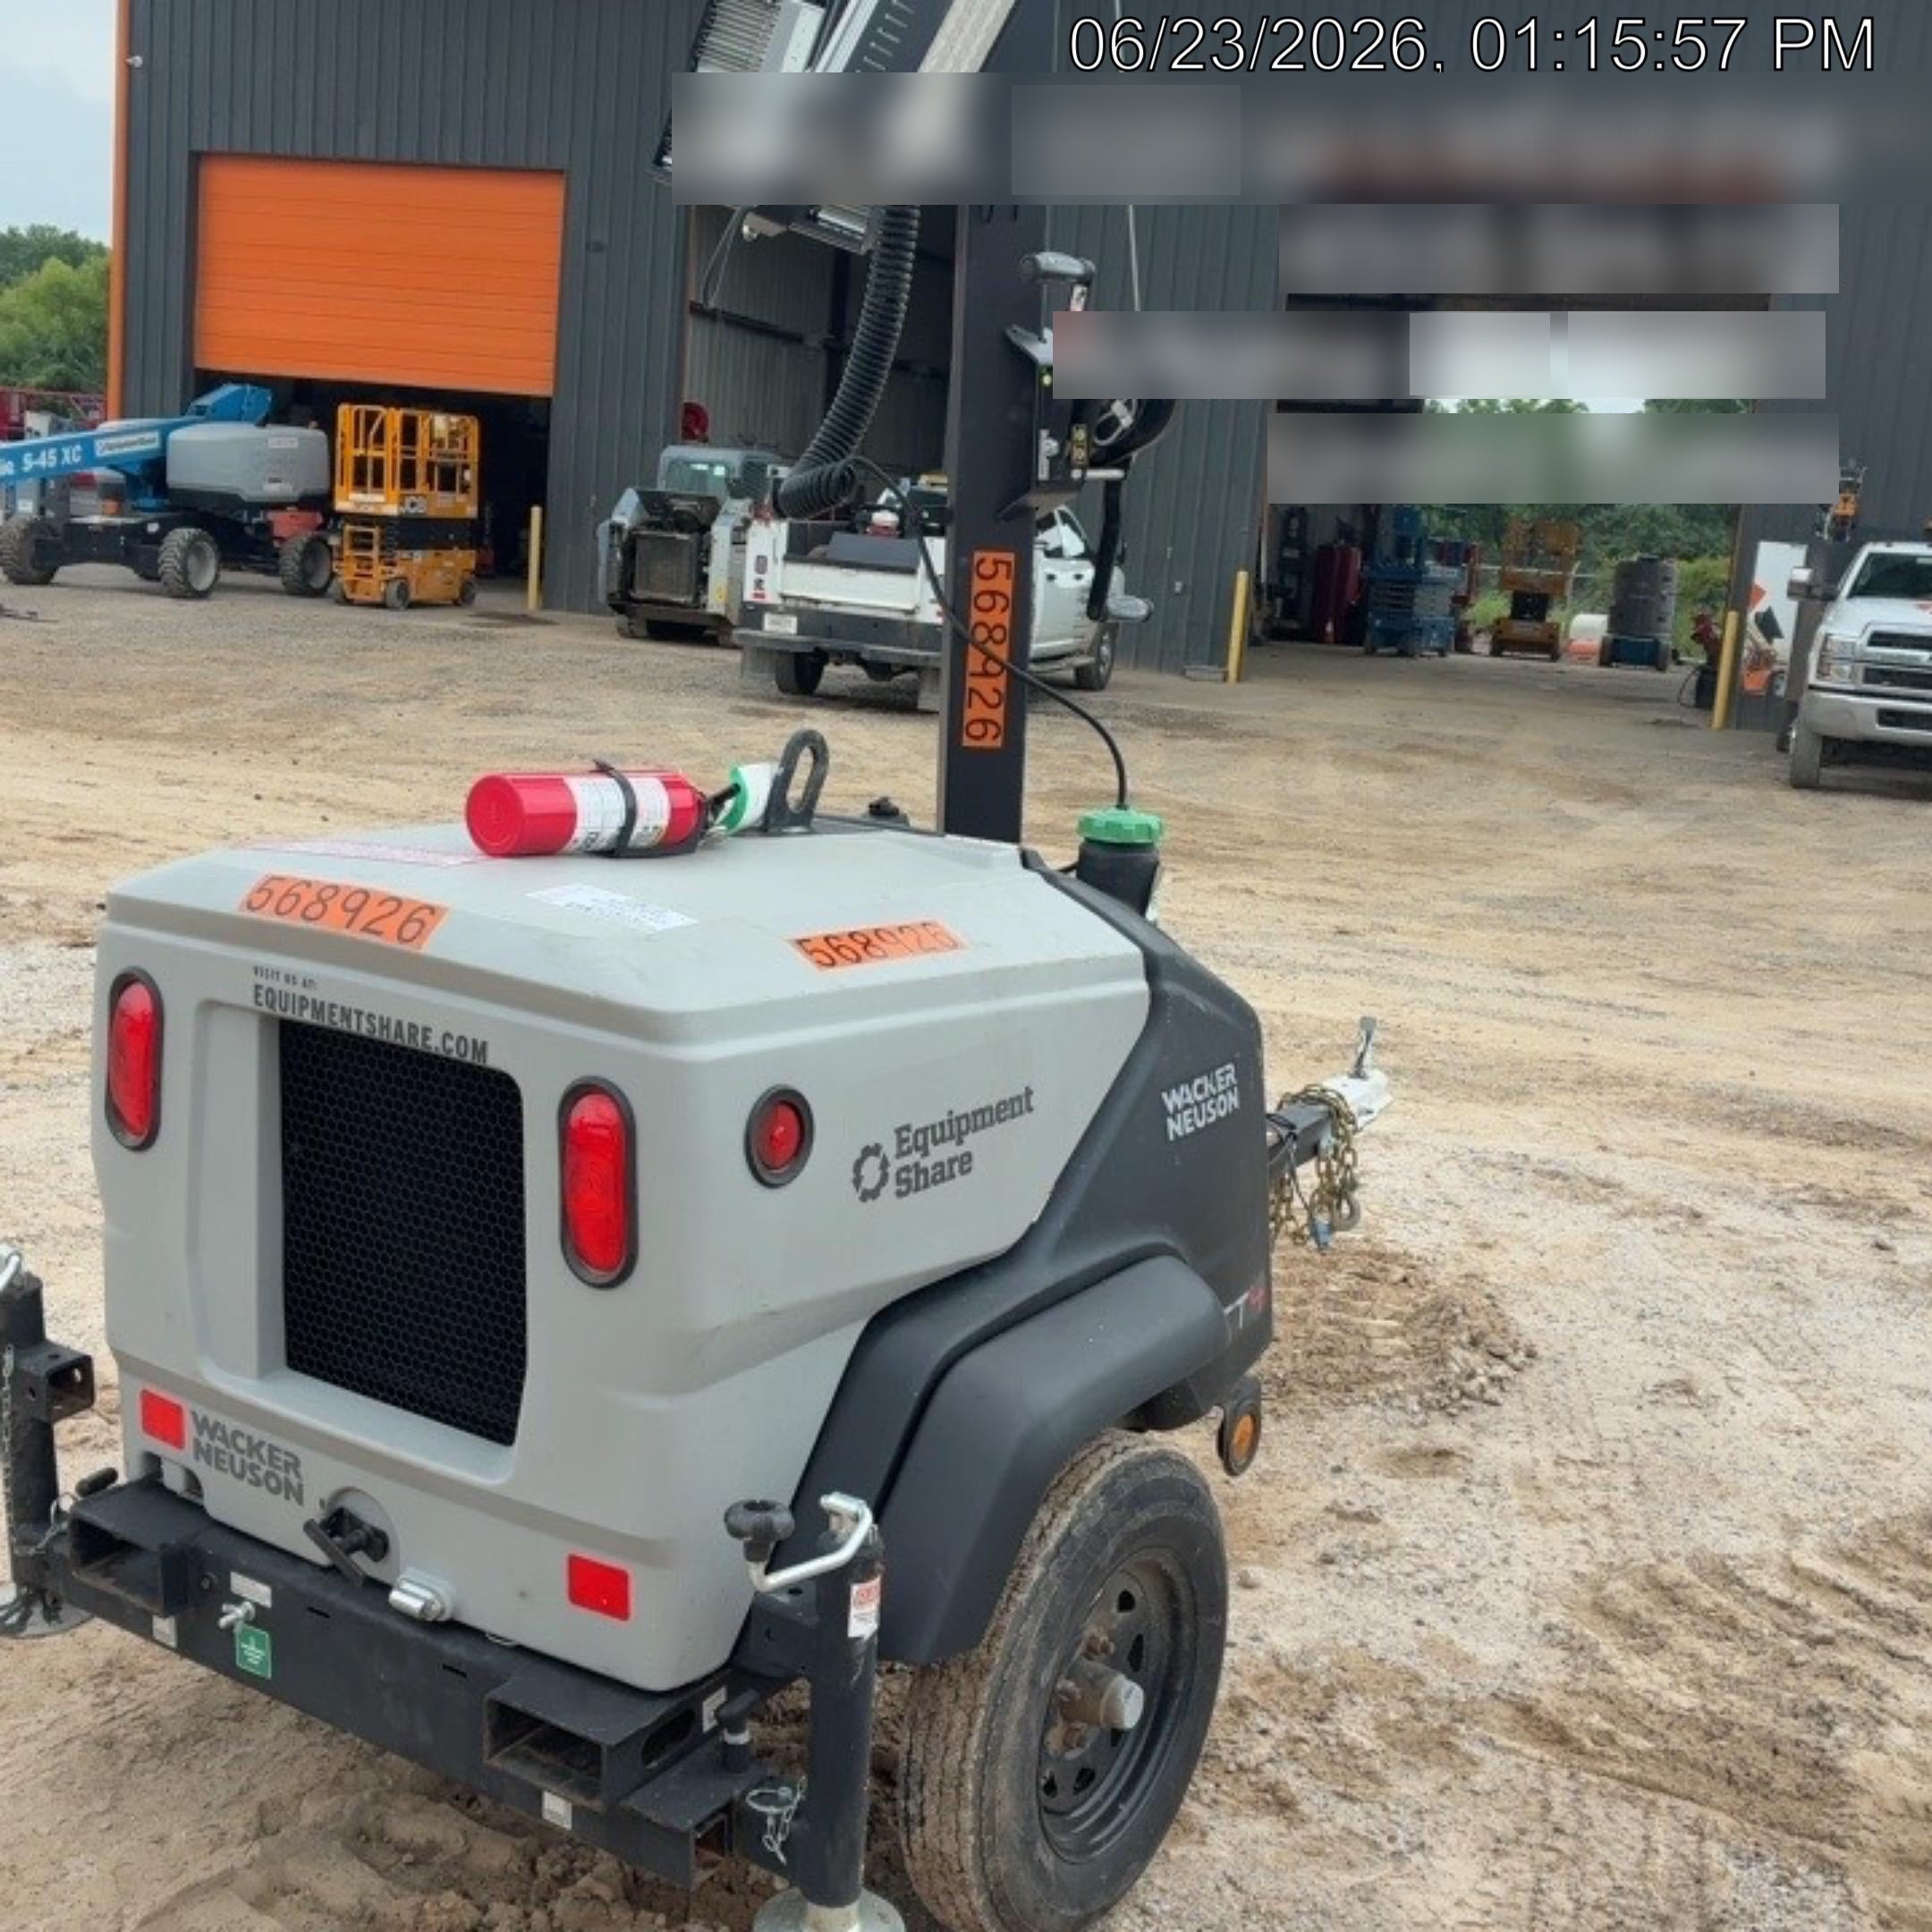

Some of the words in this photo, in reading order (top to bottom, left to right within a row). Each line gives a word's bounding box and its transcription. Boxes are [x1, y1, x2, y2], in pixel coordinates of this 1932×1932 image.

[22, 447, 58, 472] S-45
[61, 445, 82, 466] XC
[964, 557, 1013, 741] 568926
[245, 875, 436, 945] 568926
[795, 921, 959, 967] 568926
[253, 984, 488, 1064] EQUIPMENTSHARE.COM
[1161, 1061, 1238, 1114] WACKER
[1166, 1085, 1240, 1141] NEUSON
[894, 1086, 1035, 1160] Equipment
[894, 1150, 973, 1199] Share
[191, 1410, 301, 1480] WACKER
[192, 1436, 304, 1507] NEUSON
